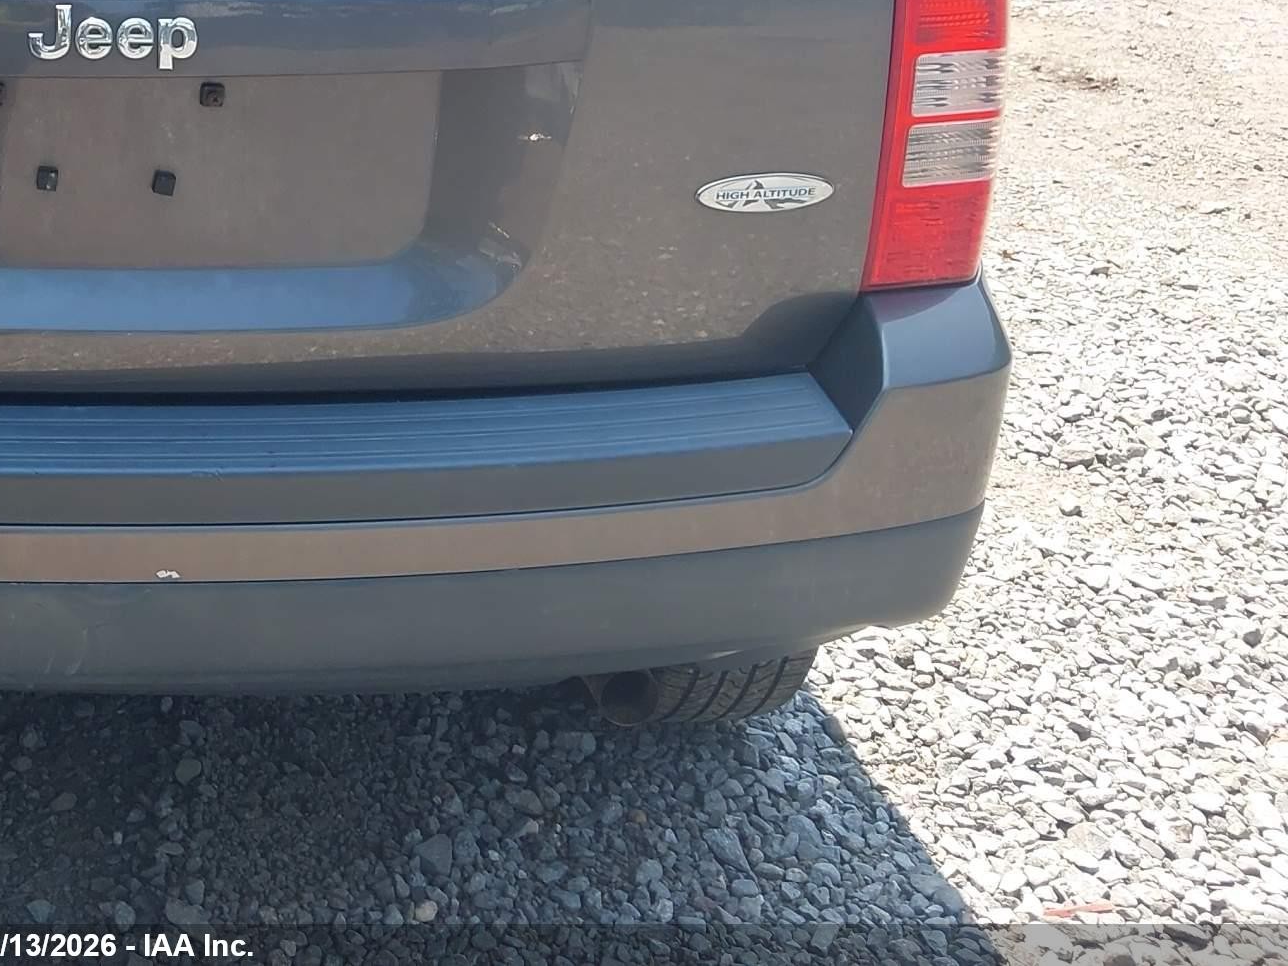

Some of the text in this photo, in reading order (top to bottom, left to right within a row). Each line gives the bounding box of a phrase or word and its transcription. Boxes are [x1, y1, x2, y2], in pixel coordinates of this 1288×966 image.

[28, 4, 199, 70] Jeep
[715, 186, 817, 202] HIGH ALTITUDE
